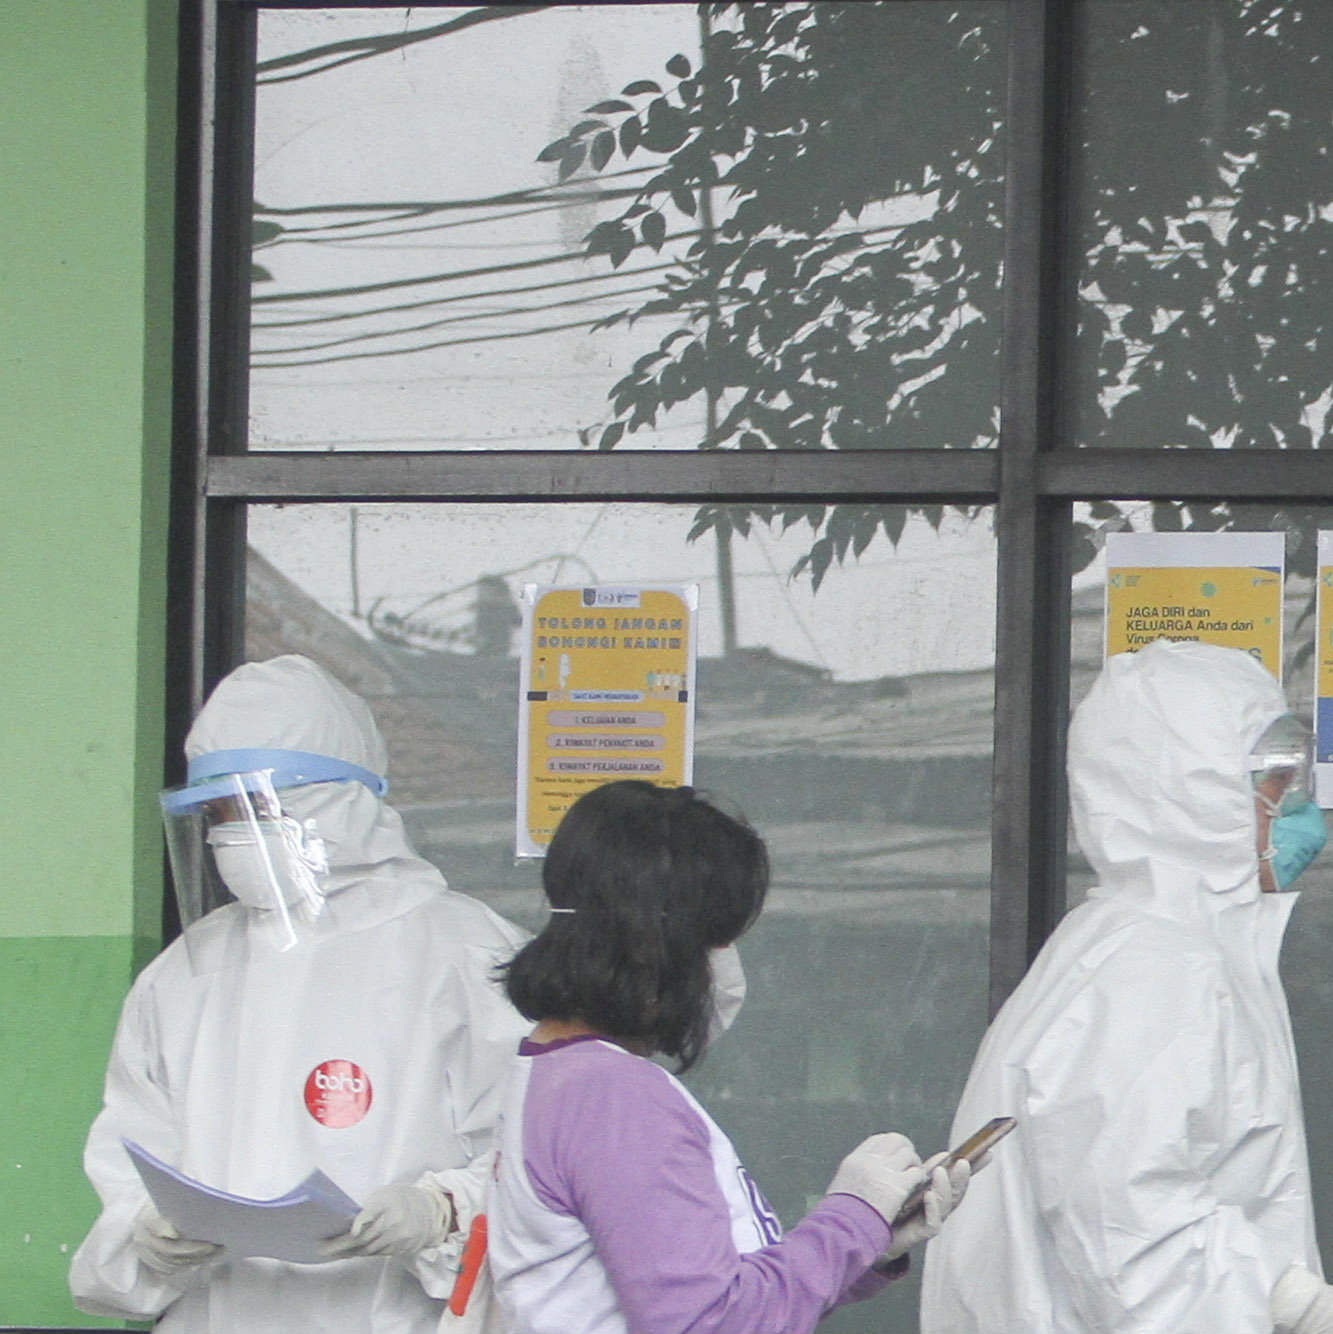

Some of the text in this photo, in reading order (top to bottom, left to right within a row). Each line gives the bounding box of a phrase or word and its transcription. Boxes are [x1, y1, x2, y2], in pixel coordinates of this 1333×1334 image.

[1126, 607, 1210, 618] JAGA DIRI dan
[538, 618, 607, 629] TOLONG
[1127, 620, 1253, 631] KELUARGA Anda dari
